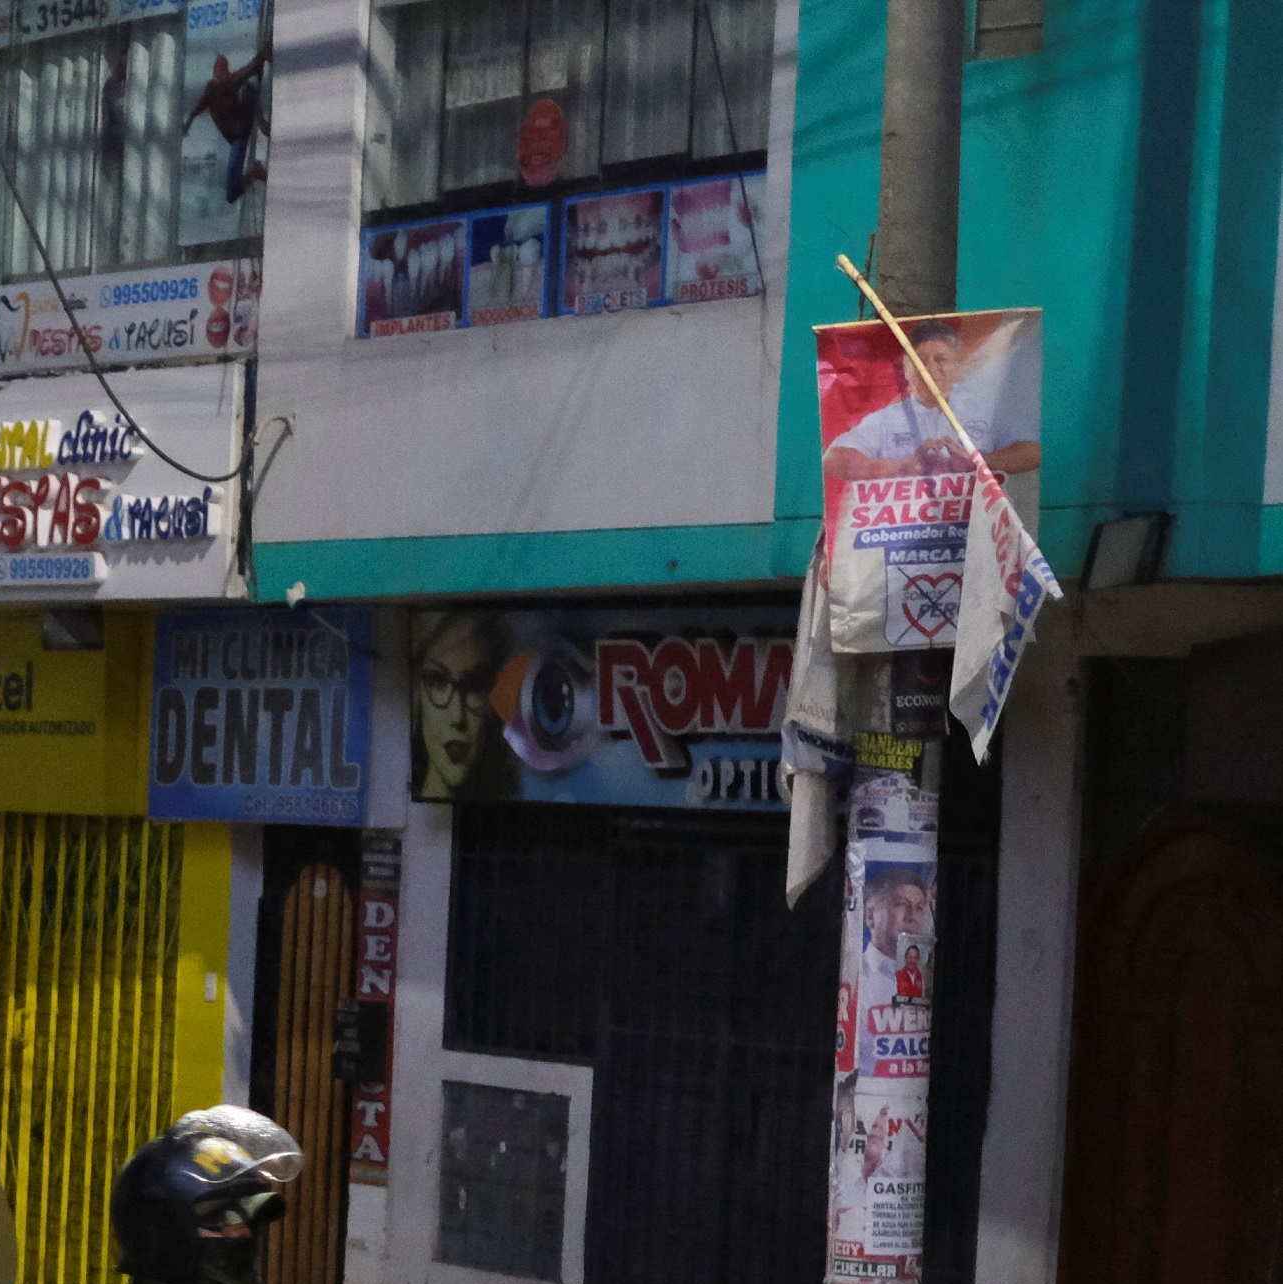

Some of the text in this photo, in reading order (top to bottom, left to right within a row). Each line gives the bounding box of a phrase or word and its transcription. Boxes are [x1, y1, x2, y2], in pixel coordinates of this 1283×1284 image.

[112, 277, 199, 306] 995509926
[374, 314, 451, 337] IMPLANTES
[857, 472, 1006, 503] WERN
[850, 500, 972, 527] SALCE
[860, 527, 943, 544] Gobernador
[9, 556, 91, 580] 995509926
[918, 602, 959, 620] PER
[173, 631, 210, 679] MI
[155, 685, 362, 791] DENTAL
